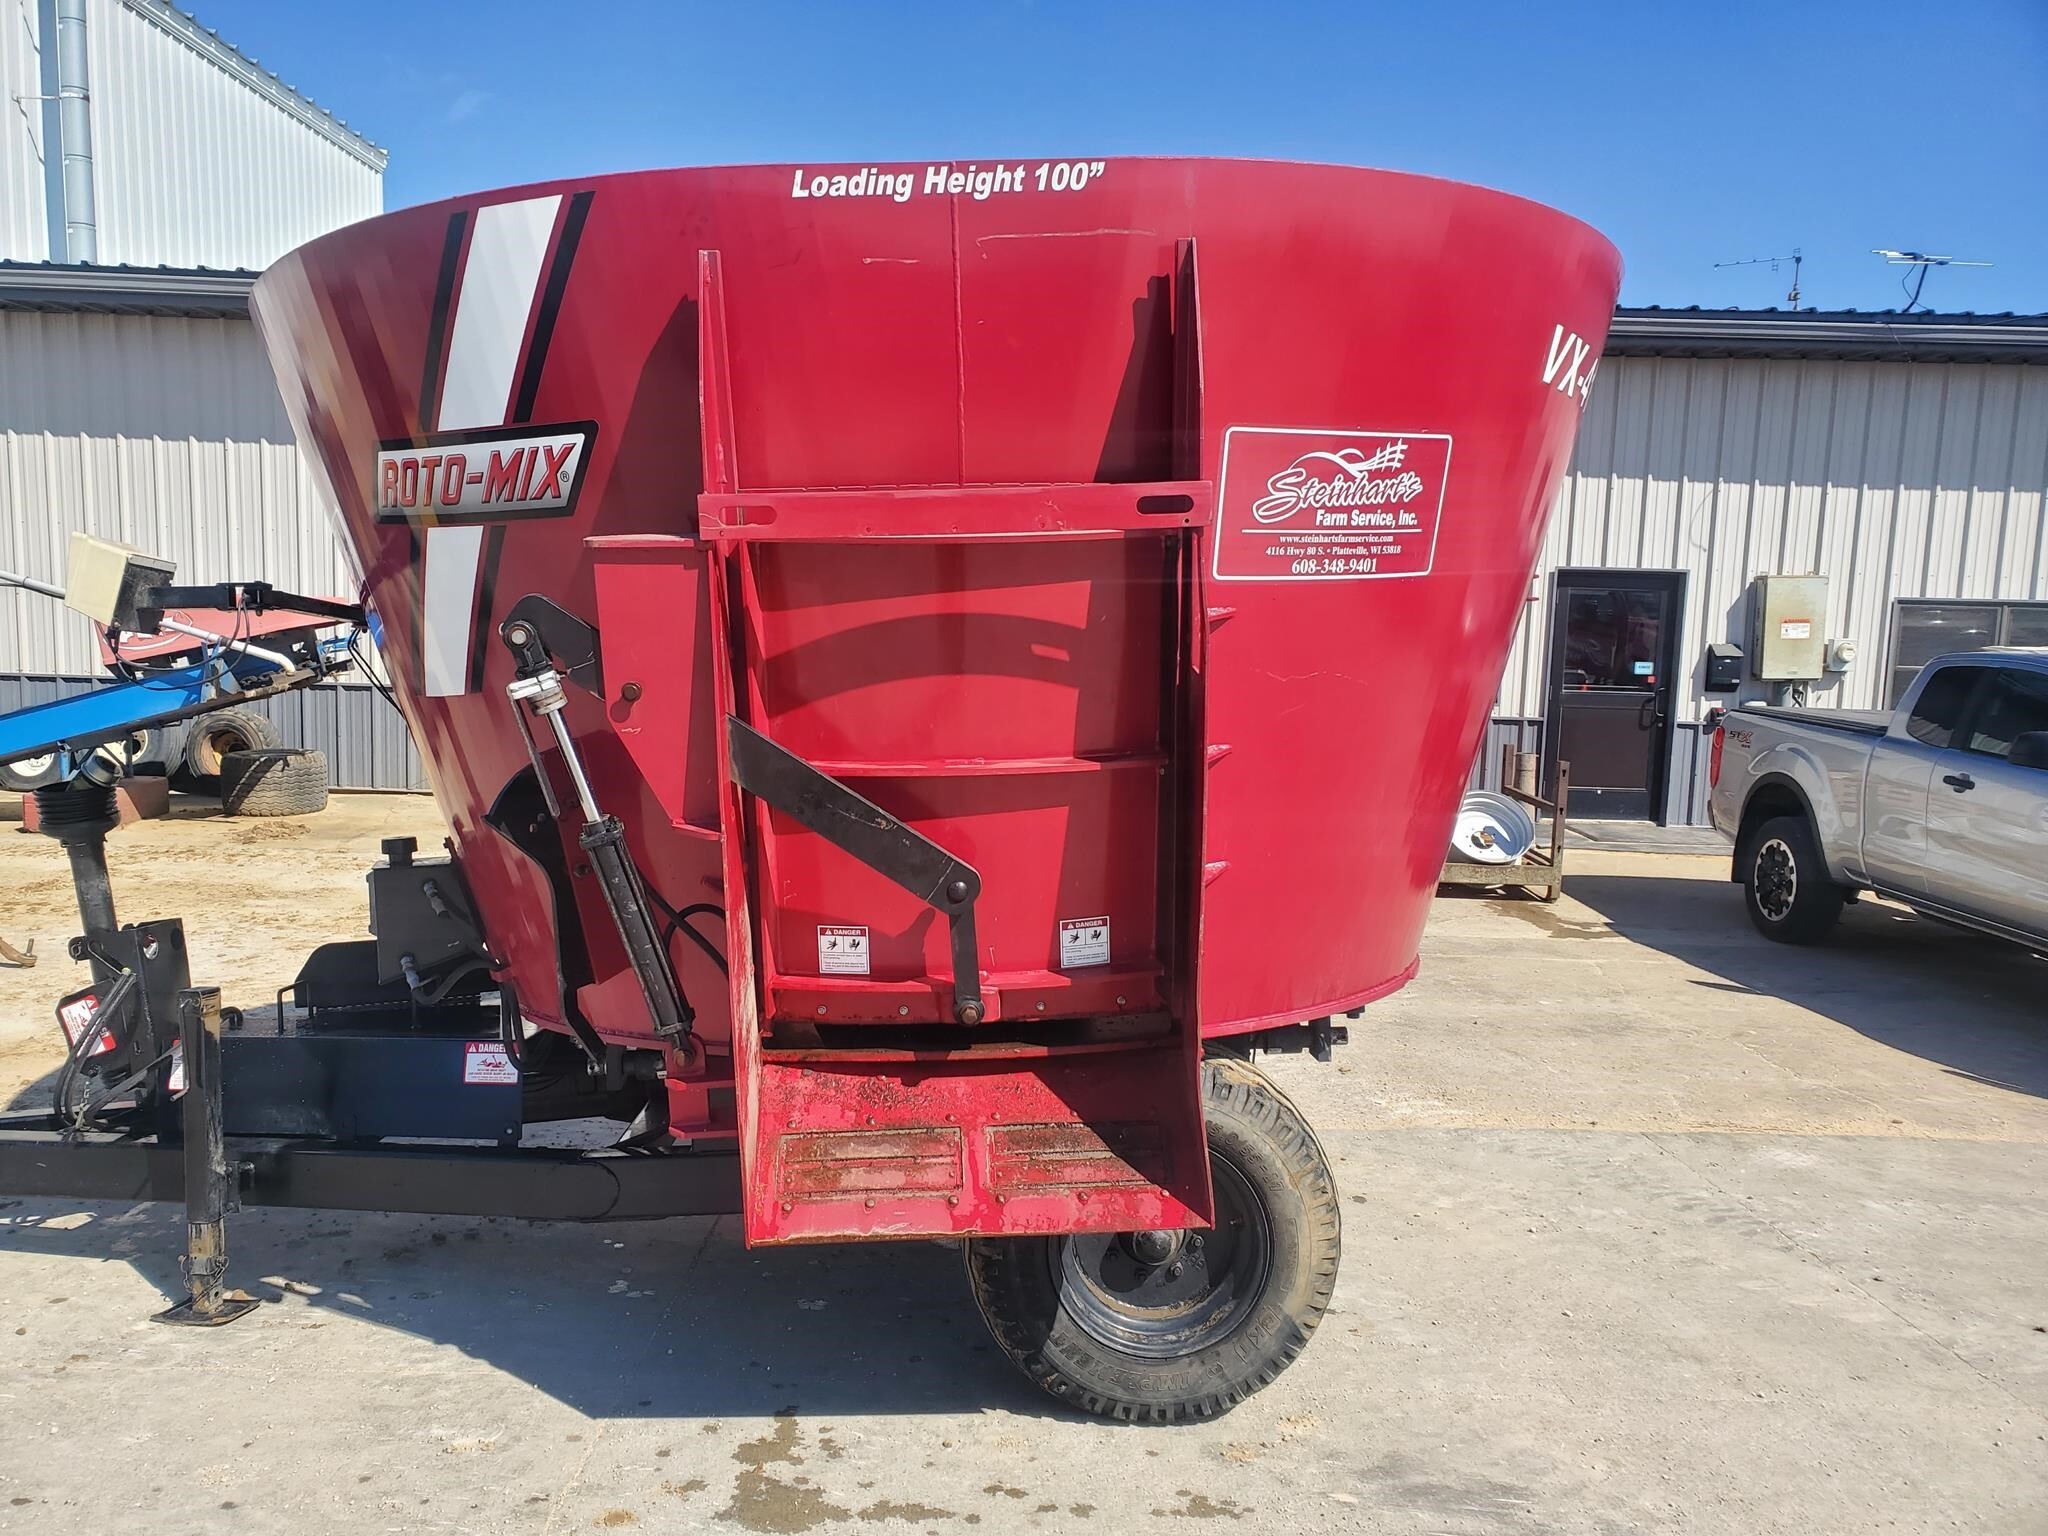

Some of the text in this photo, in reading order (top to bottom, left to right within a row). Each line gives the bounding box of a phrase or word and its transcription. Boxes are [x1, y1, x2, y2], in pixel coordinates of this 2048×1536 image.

[792, 168, 914, 202] Loading
[923, 165, 1025, 200] Height
[1542, 323, 1600, 412] VX-4
[1252, 467, 1424, 524] Steinhart's
[1315, 509, 1418, 529] Farm Service, Inc.
[1279, 533, 1394, 543] www.steinhartsfarmservice.com
[1265, 546, 1285, 556] 4116
[1286, 546, 1304, 557] Hwy
[1306, 546, 1317, 556] 80
[1332, 546, 1369, 557] Platteville,
[1291, 557, 1377, 575] 608-348-9401
[833, 928, 861, 936] DANGER
[1075, 919, 1103, 928] DANGER
